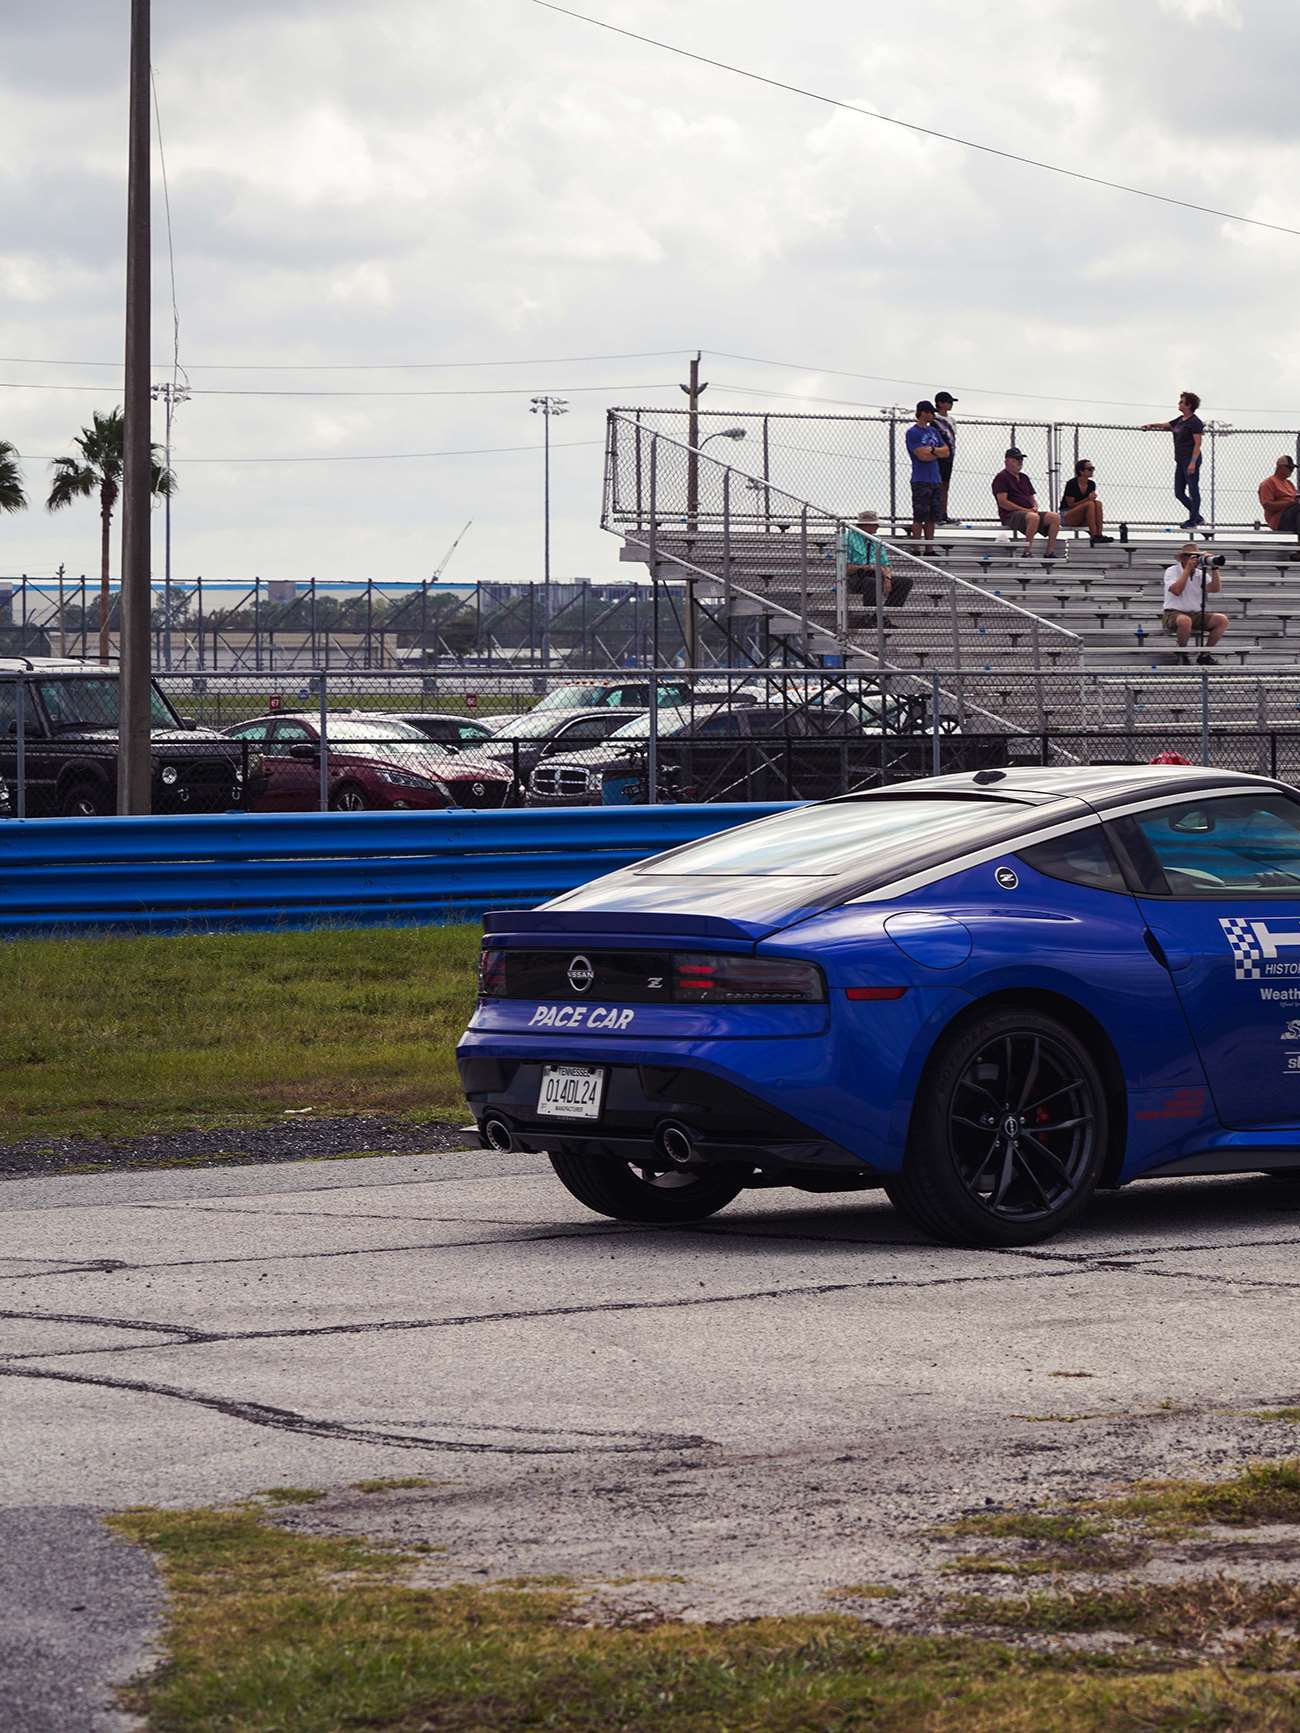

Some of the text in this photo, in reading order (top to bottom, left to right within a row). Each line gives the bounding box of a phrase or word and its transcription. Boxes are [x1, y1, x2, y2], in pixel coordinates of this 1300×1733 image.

[647, 977, 663, 988] Z
[528, 1006, 635, 1030] PACE CAR
[546, 1078, 598, 1105] 014DL24
